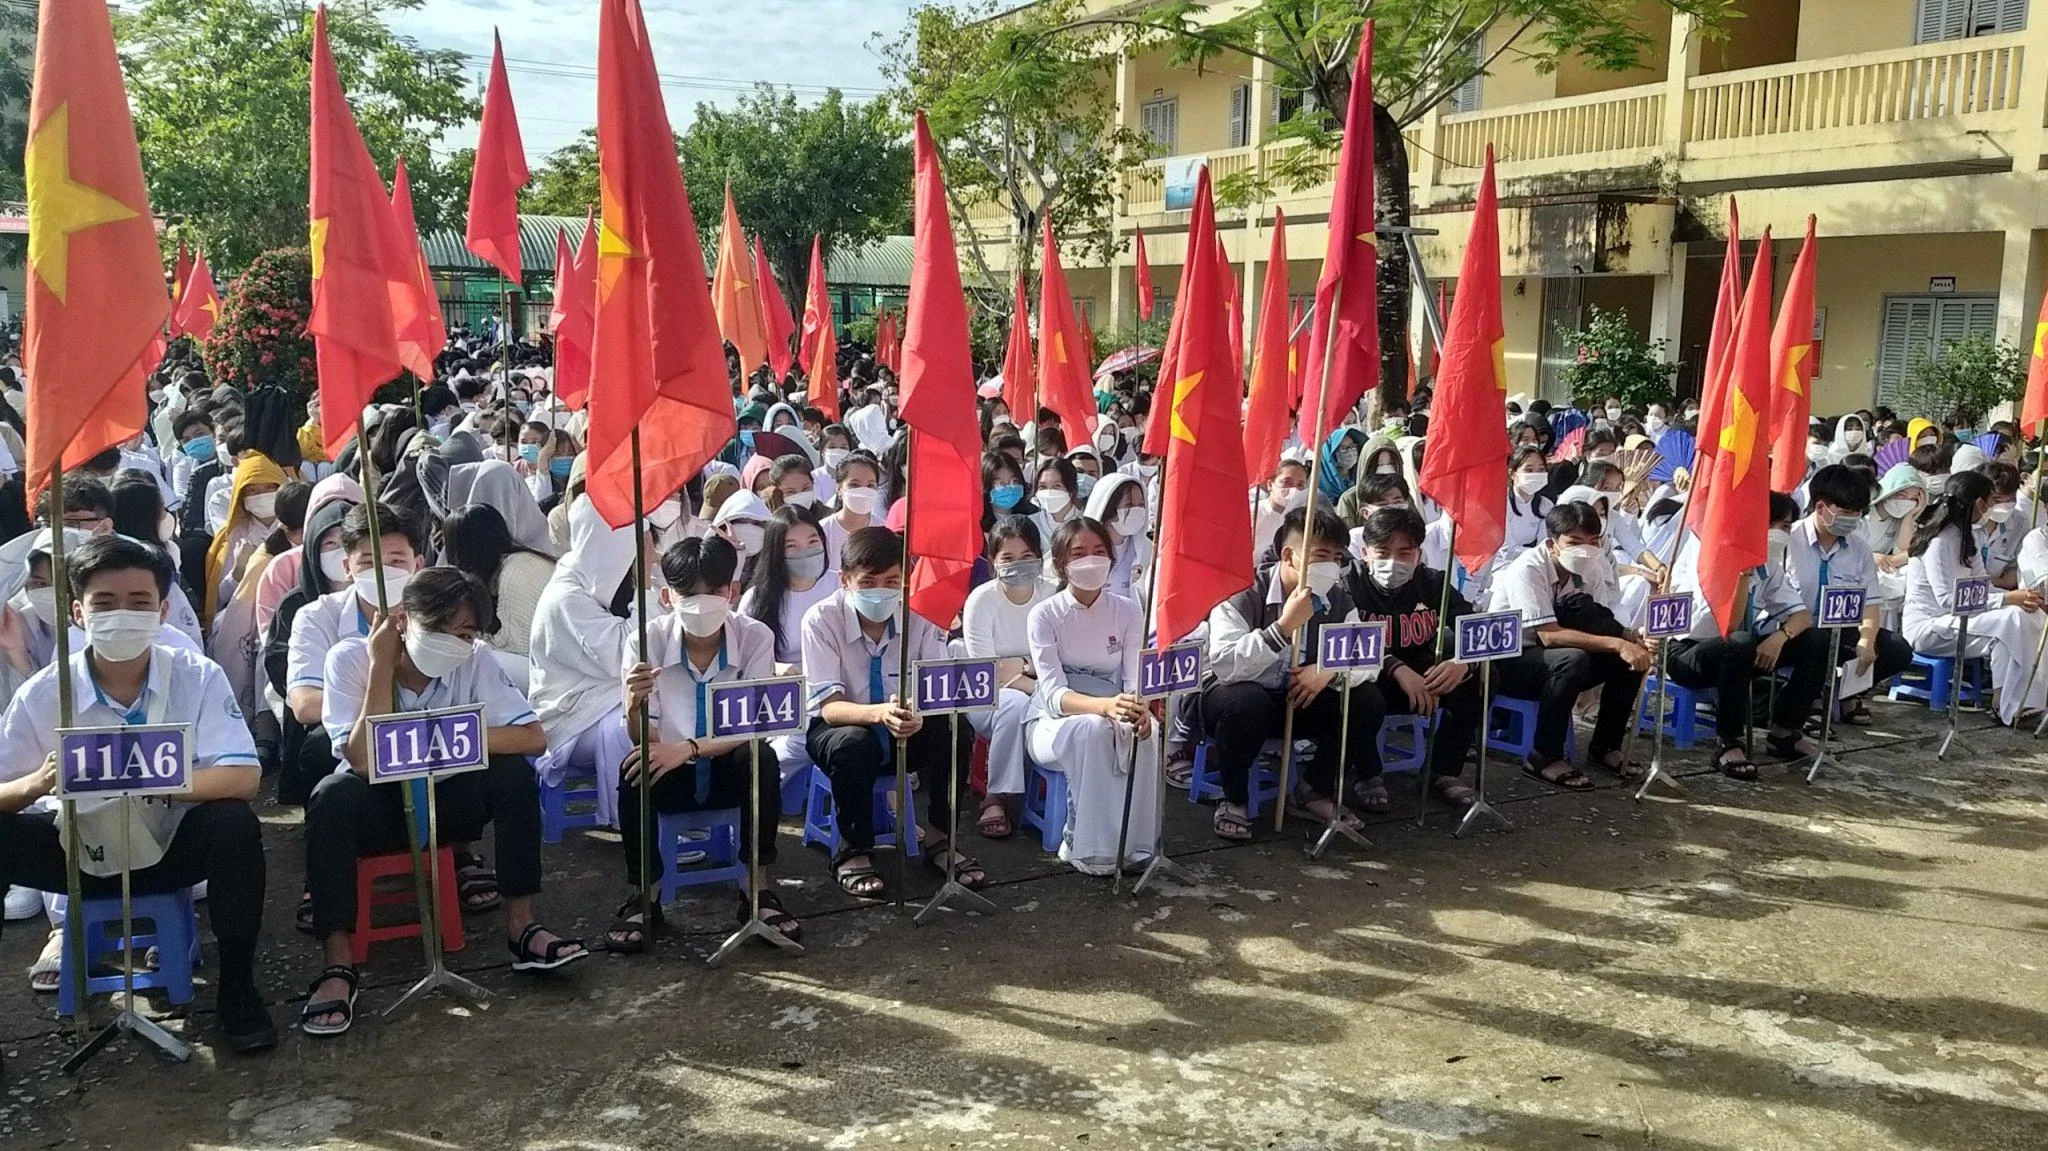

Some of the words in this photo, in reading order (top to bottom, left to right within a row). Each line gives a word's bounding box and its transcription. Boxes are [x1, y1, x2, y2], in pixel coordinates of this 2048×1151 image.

[1826, 592, 1861, 620] 12C3
[1956, 585, 1985, 607] 12C2
[1651, 602, 1687, 631] 12C4
[1327, 632, 1377, 662] 11A1
[1467, 621, 1513, 652] 12C5
[923, 671, 990, 703] 11A3
[1145, 655, 1196, 690] 11A2
[718, 691, 794, 729] 11A4
[386, 721, 471, 766] 11A5
[72, 741, 178, 783] 11A6
